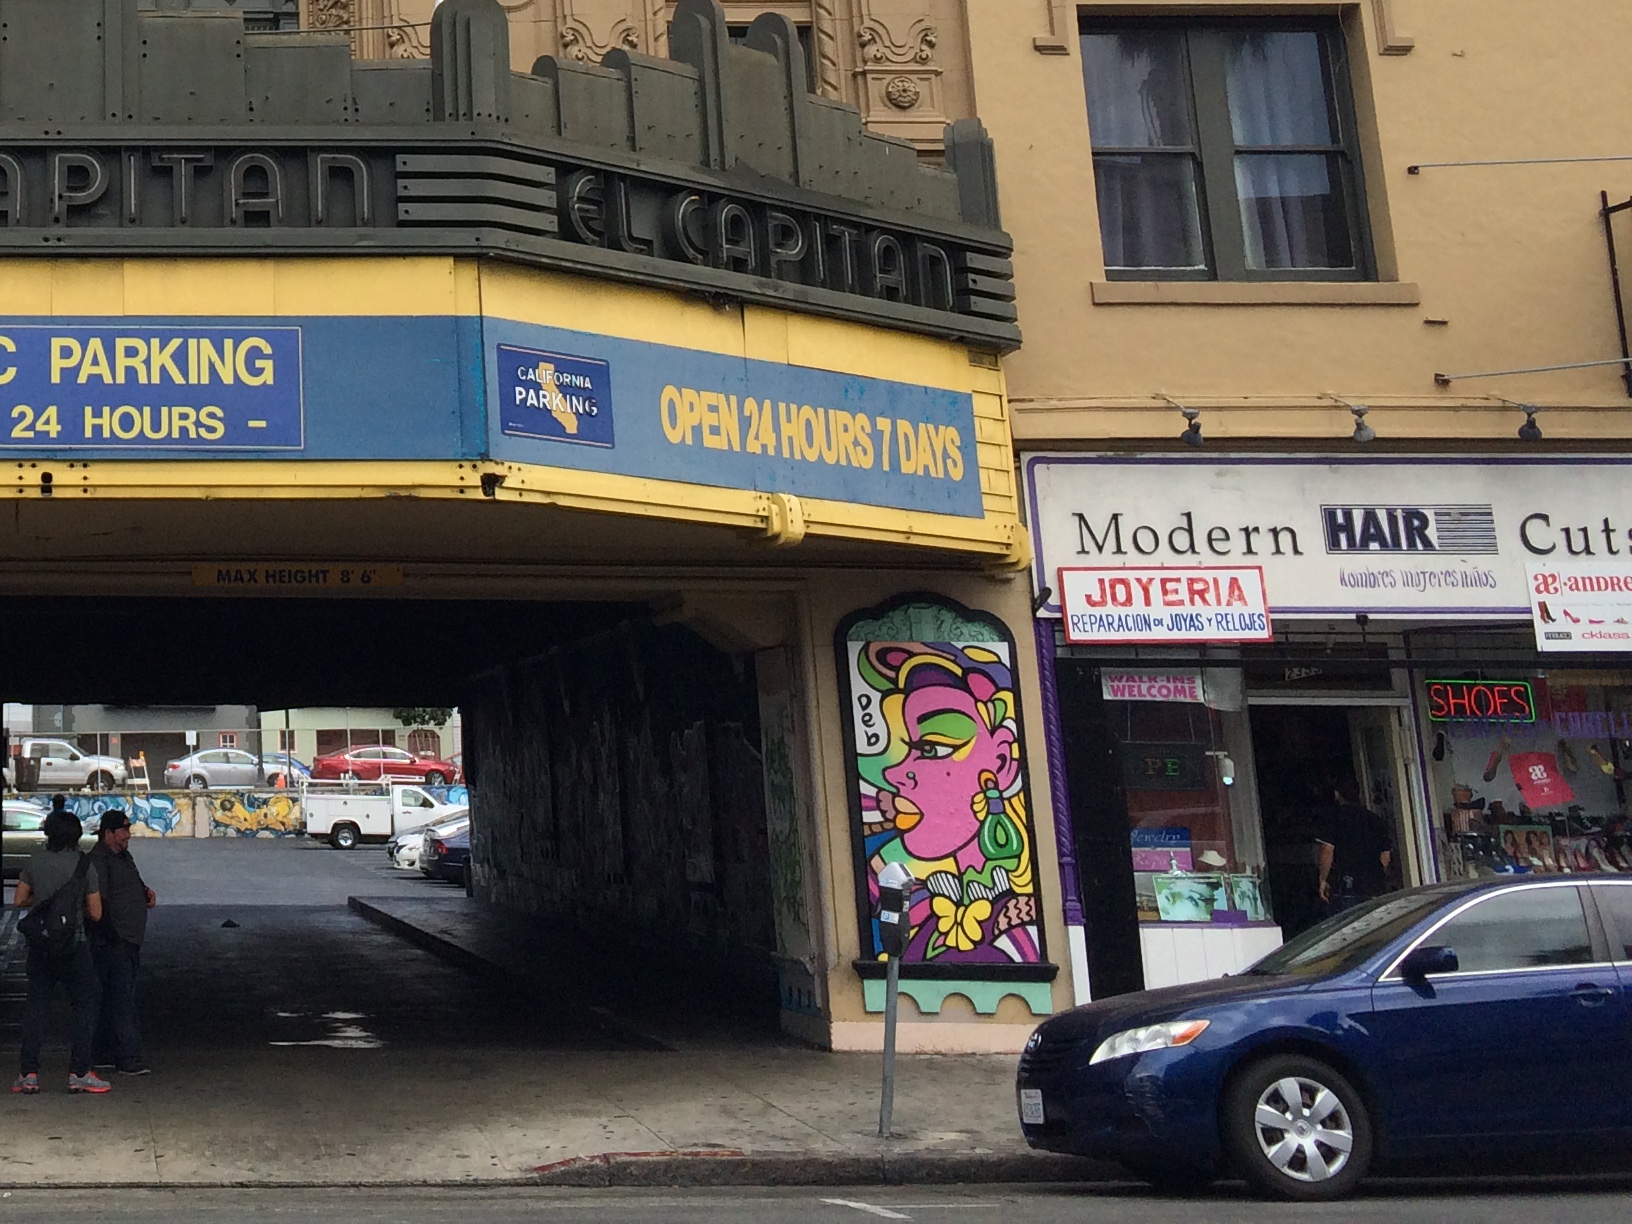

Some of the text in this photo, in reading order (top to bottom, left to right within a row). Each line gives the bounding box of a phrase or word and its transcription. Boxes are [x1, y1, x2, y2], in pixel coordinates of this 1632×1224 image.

[568, 169, 958, 312] EL CAPITAN
[50, 335, 275, 386] PARKING
[517, 366, 593, 390] CALIFORNIA
[514, 386, 598, 417] PARKING
[11, 404, 62, 438] 24
[84, 404, 225, 440] HOURS
[660, 384, 965, 482] OPEN 24 HOURS 7 DAYS
[1071, 507, 1632, 556] Modern HAIR Cut
[217, 569, 258, 584] MAX
[265, 569, 330, 584] HEIGHT
[1084, 577, 1249, 608] JOYERIA
[1070, 613, 1152, 633] REPARACION
[1166, 613, 1205, 632] JOYAS
[1214, 612, 1266, 632] RELOJES
[1109, 684, 1198, 699] WELCOME
